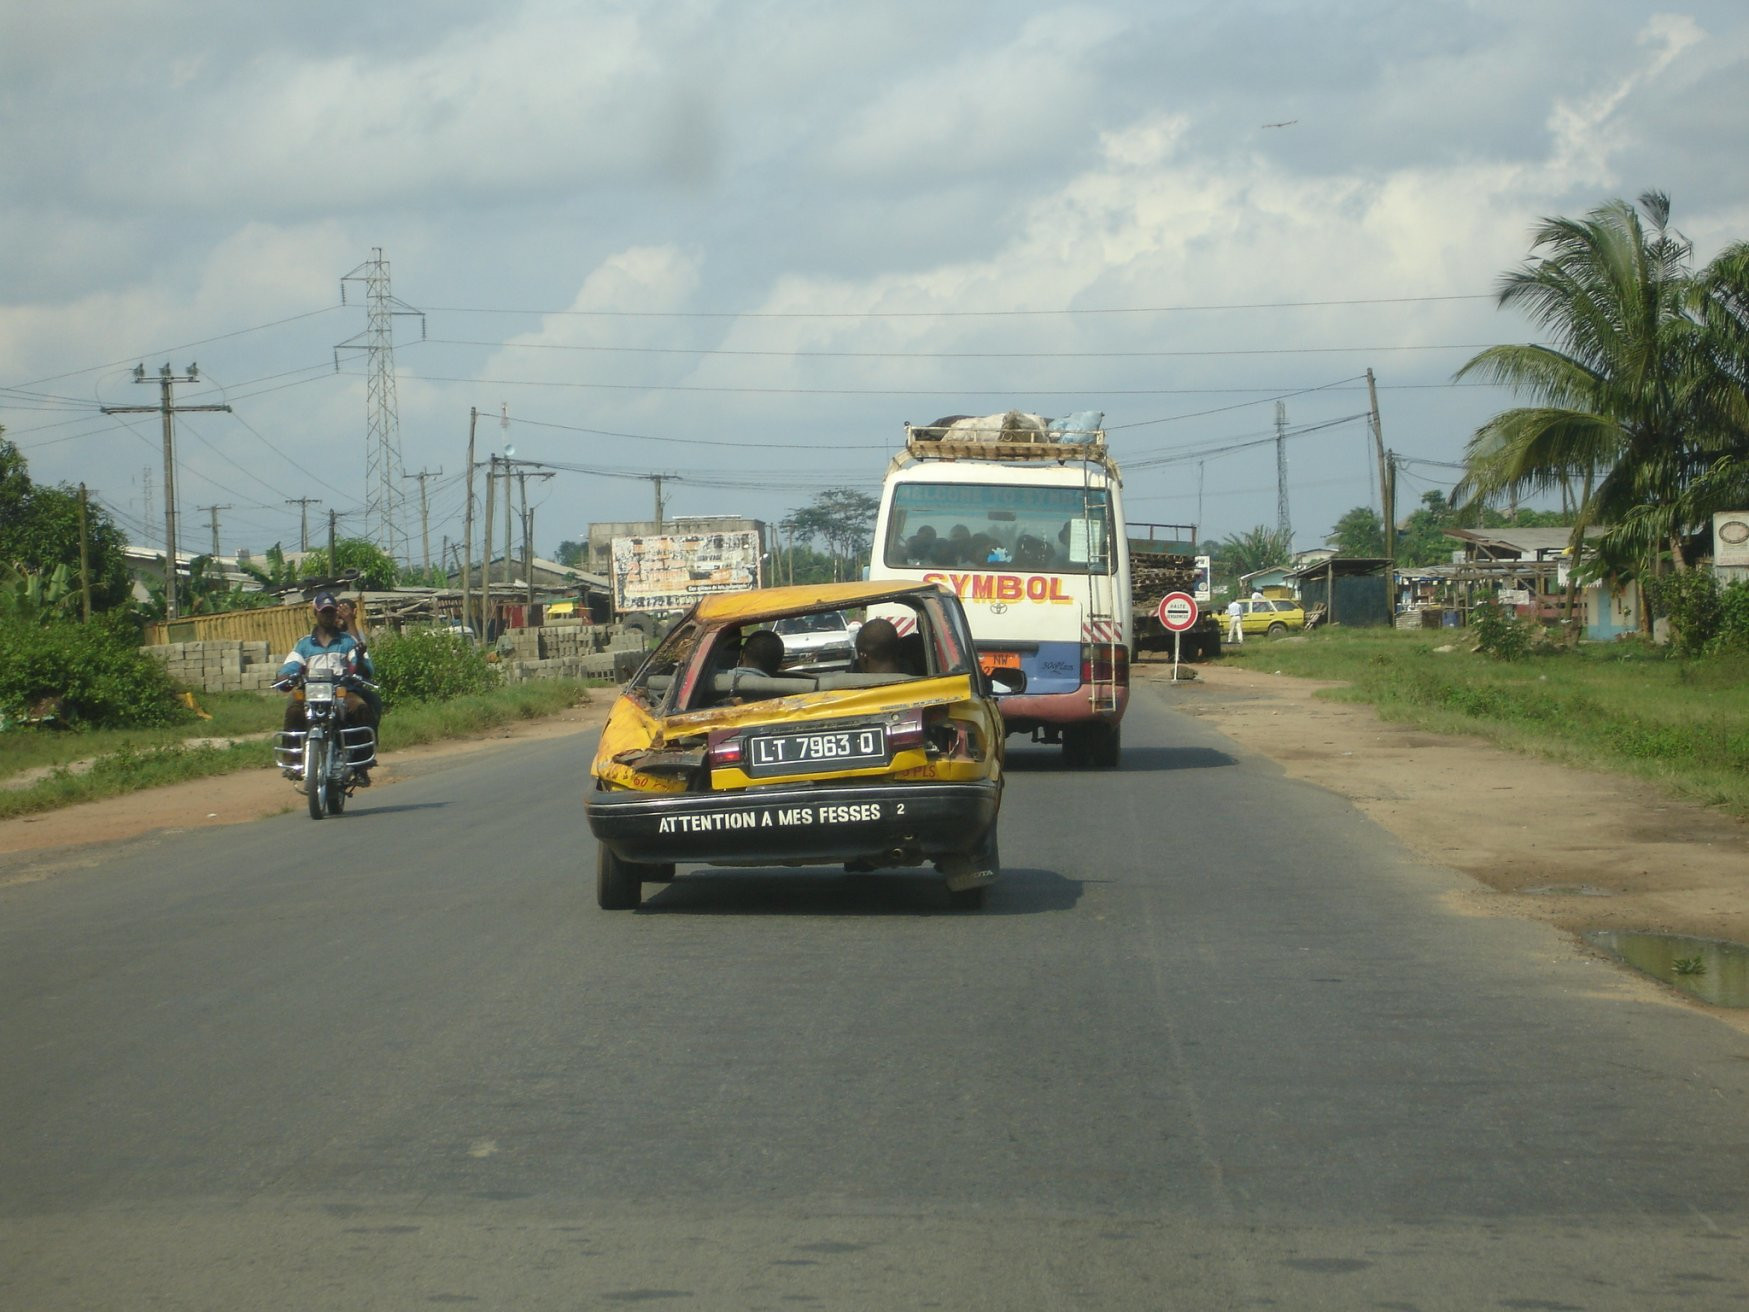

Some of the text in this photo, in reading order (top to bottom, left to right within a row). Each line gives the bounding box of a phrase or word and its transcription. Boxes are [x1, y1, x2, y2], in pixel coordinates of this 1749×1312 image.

[993, 655, 1008, 665] NW
[760, 739, 785, 762] LT
[799, 734, 851, 759] 7963
[659, 803, 905, 833] ATTENTION A MES FESSES 2
